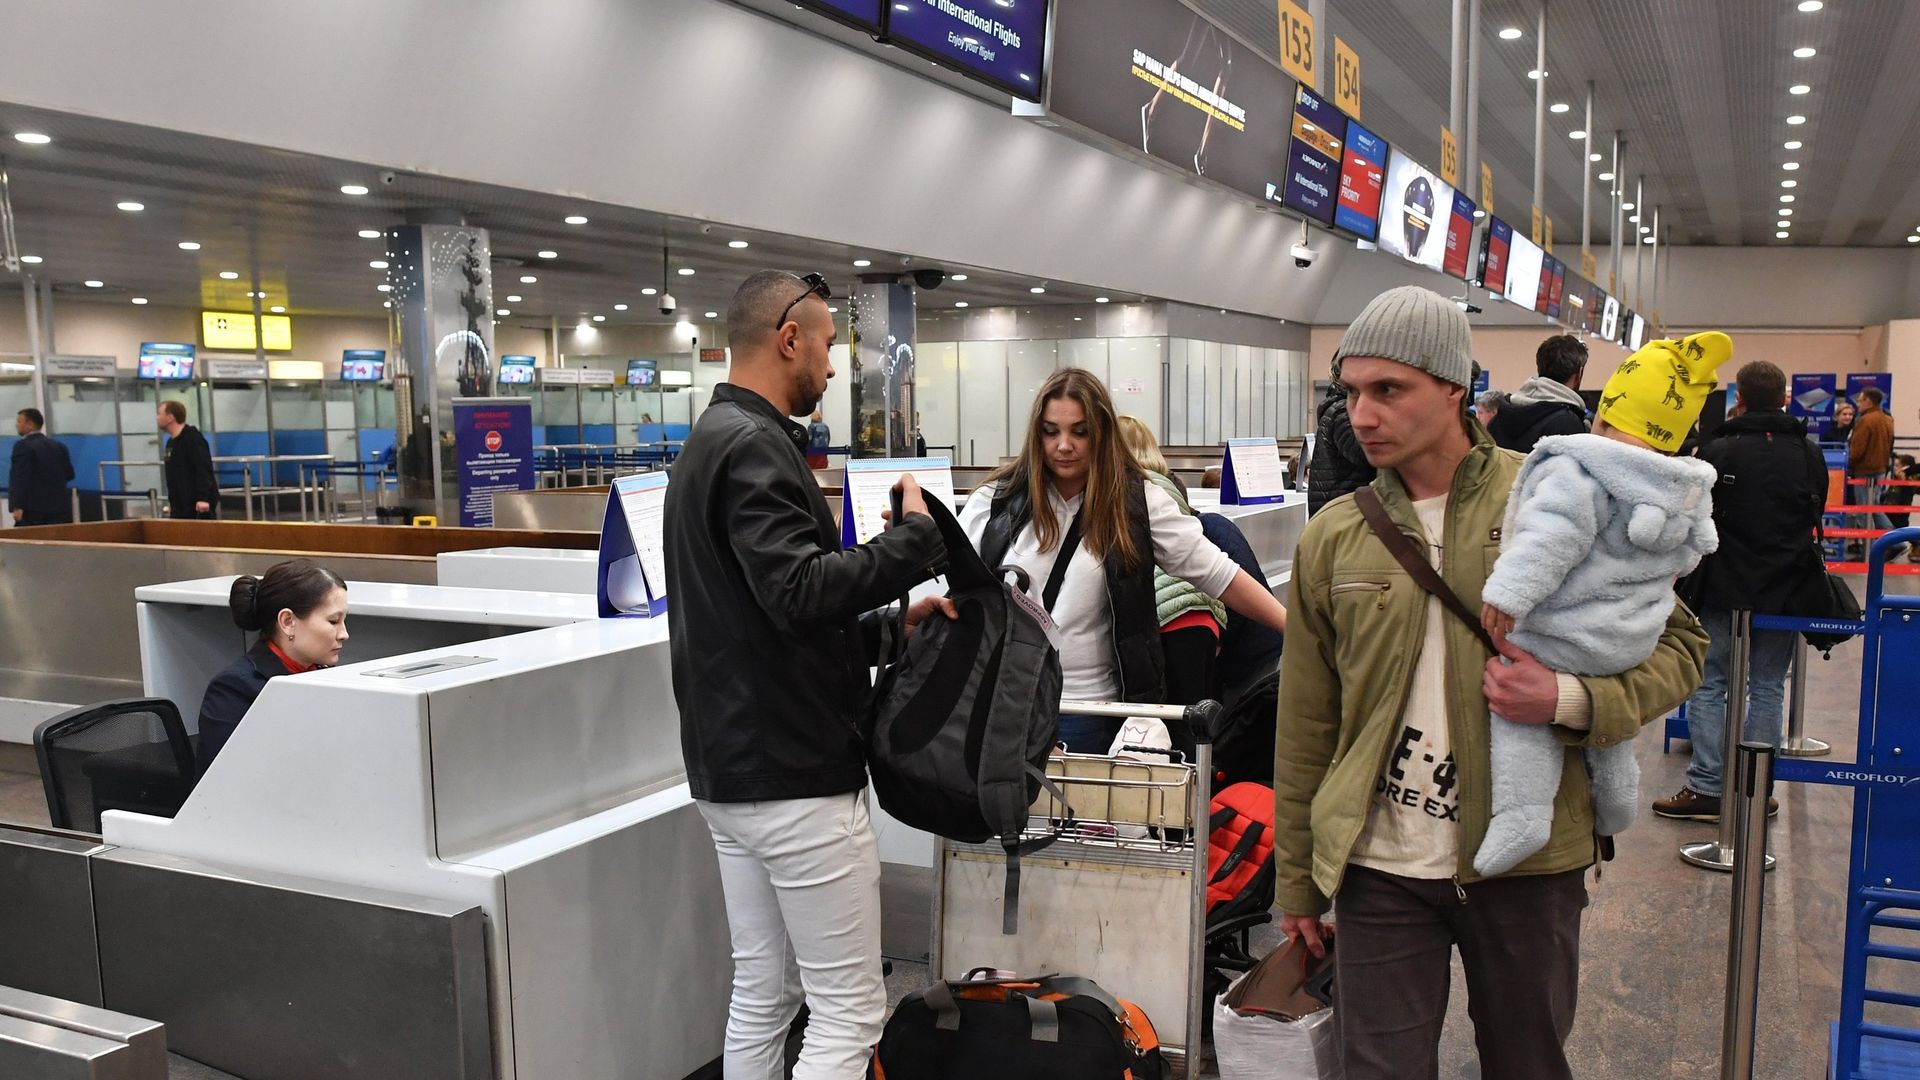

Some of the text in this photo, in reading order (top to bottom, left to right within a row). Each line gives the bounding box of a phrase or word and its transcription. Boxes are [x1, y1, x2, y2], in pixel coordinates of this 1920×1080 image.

[948, 31, 995, 61] Enjoy your flight!
[993, 21, 1020, 48] Flights
[1282, 11, 1312, 72] 153
[1132, 48, 1146, 67] SAP
[1337, 53, 1358, 106] 154
[1301, 92, 1319, 111] DROP OFF
[1442, 137, 1456, 176] 155
[1015, 594, 1047, 624] APPROVED
[1809, 622, 1857, 632] AEROFLOT
[1825, 770, 1907, 784] AEROFLOT
[1423, 797, 1460, 823] EX
